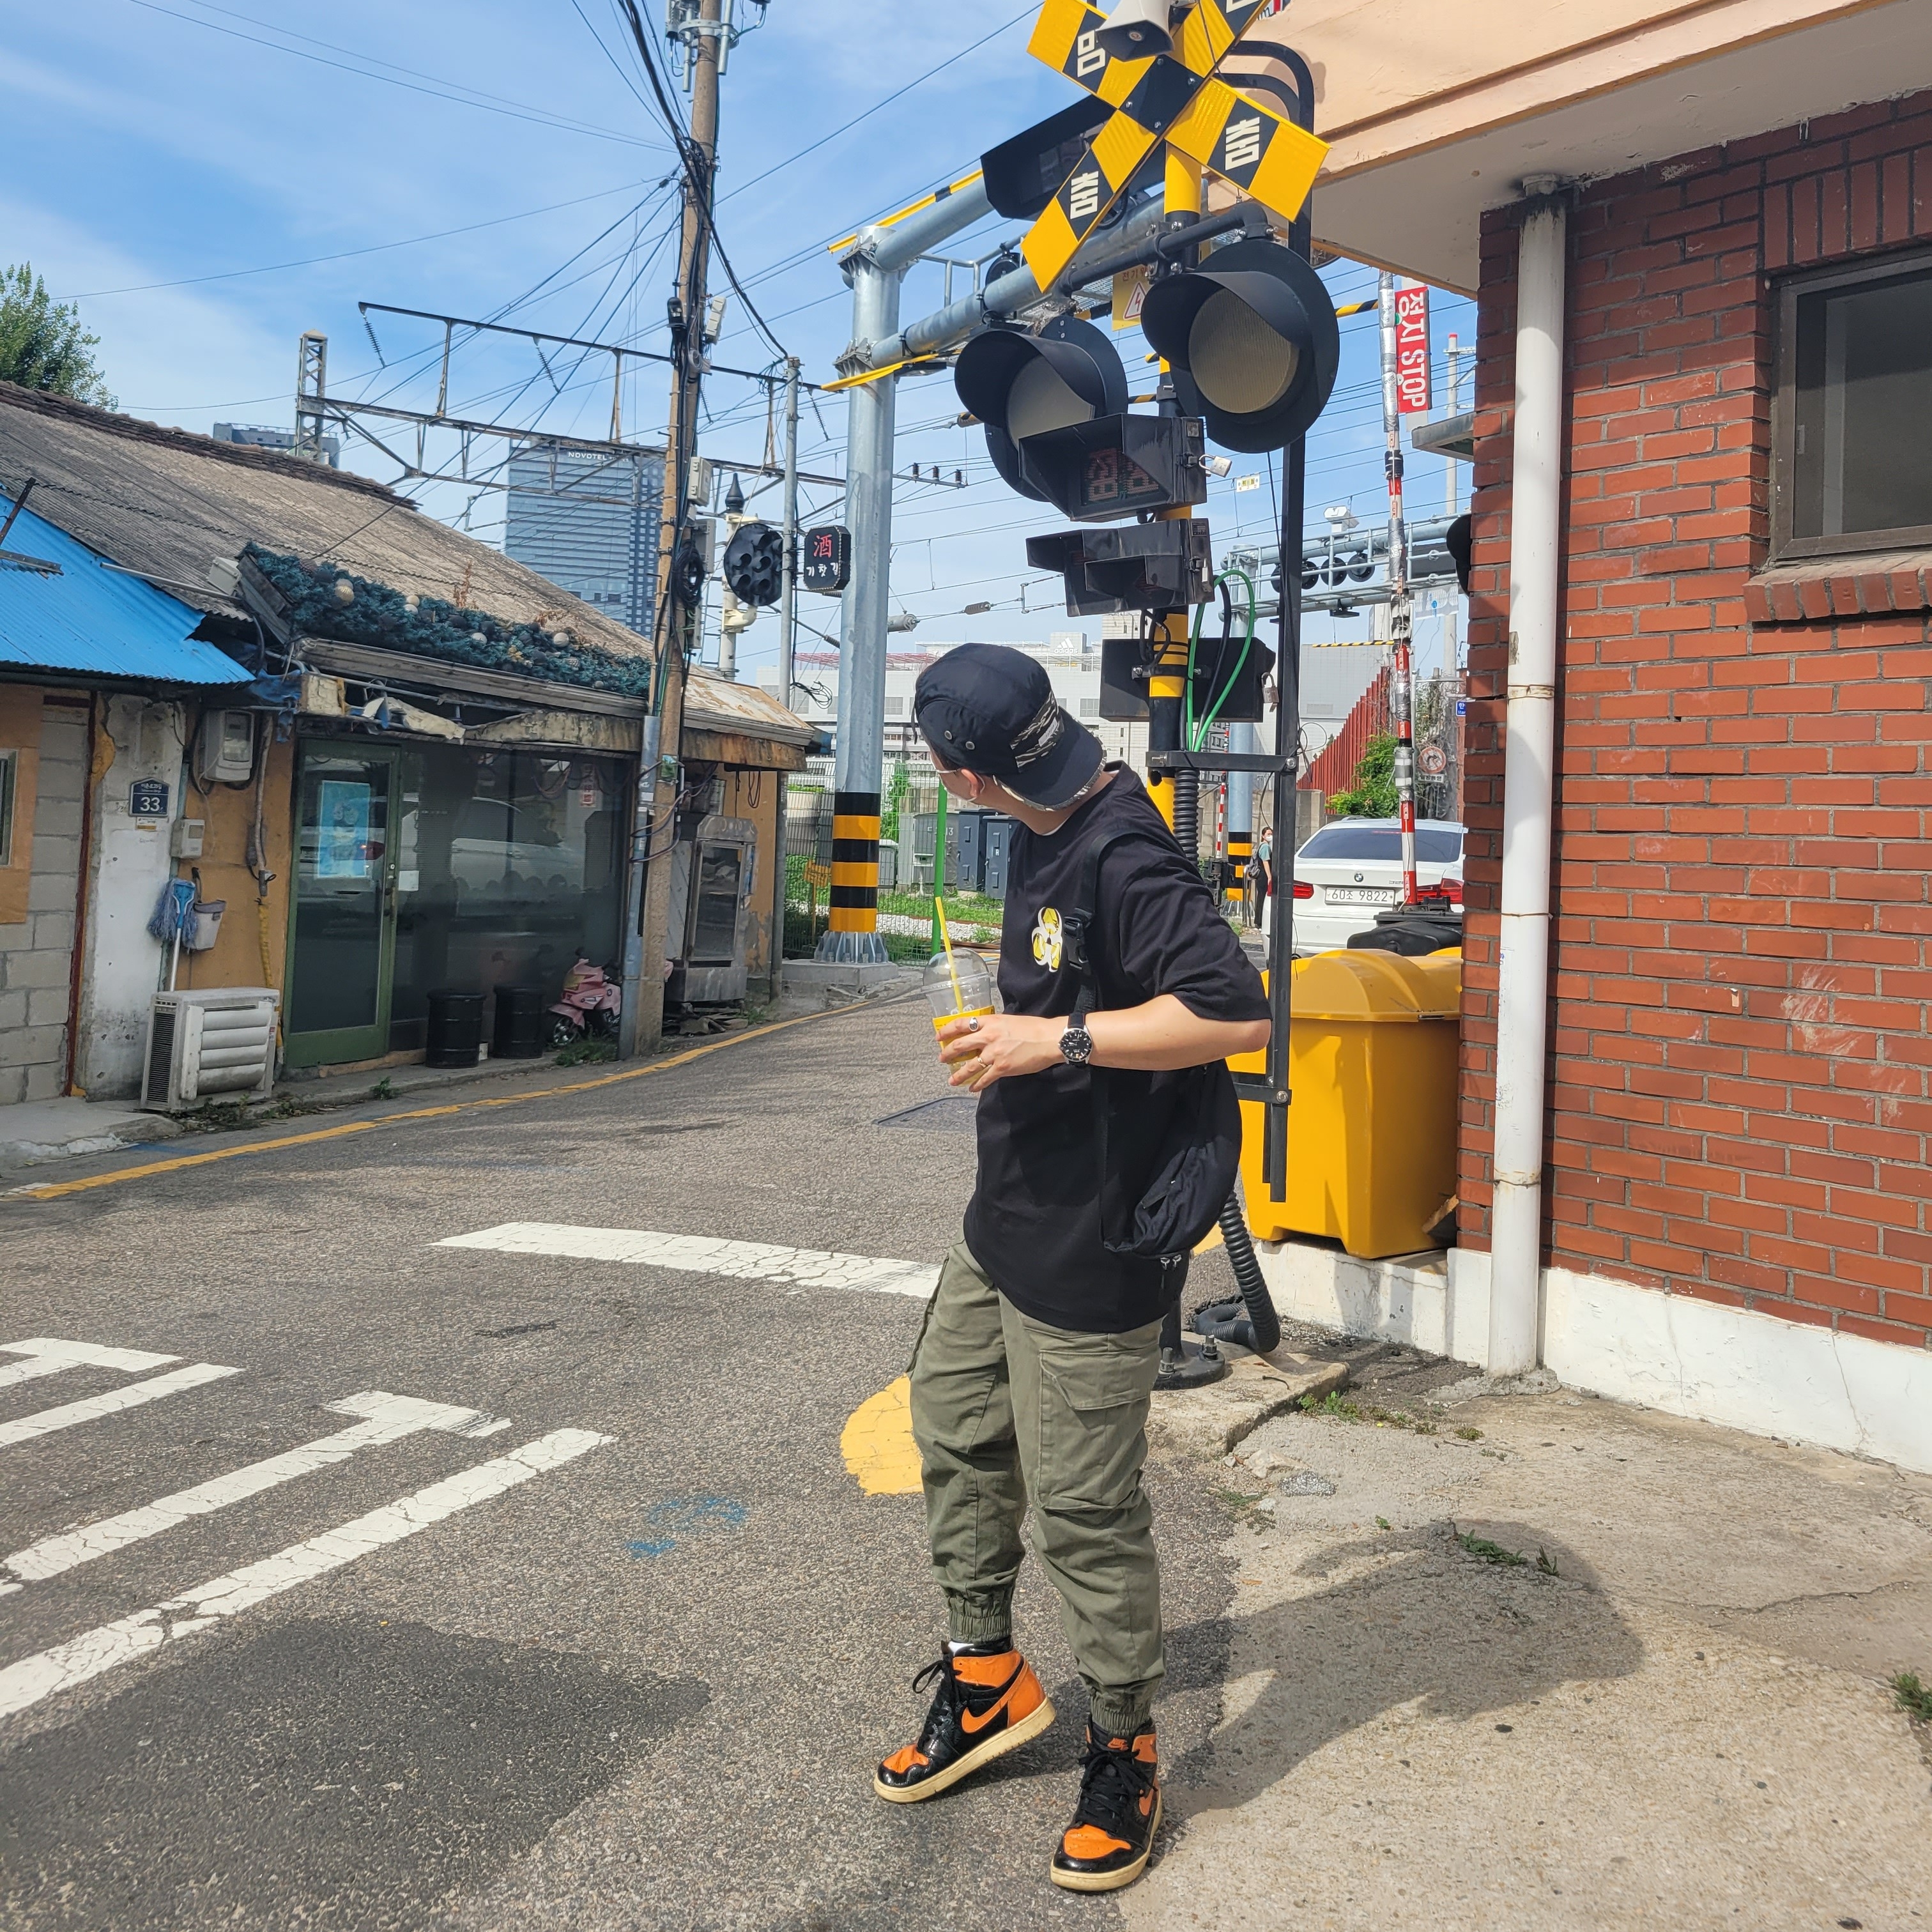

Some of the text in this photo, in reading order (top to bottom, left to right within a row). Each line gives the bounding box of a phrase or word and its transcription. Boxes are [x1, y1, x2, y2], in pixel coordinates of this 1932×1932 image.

[1225, 116, 1261, 171] 춤
[1070, 171, 1100, 220] 춤
[1398, 291, 1425, 343] 정지
[1401, 348, 1427, 407] STOP
[567, 451, 608, 461] NOVOTEL
[813, 533, 832, 558] 酒
[806, 562, 839, 578] 기찻길
[139, 796, 161, 812] 33
[1331, 889, 1388, 902] 60조 9822
